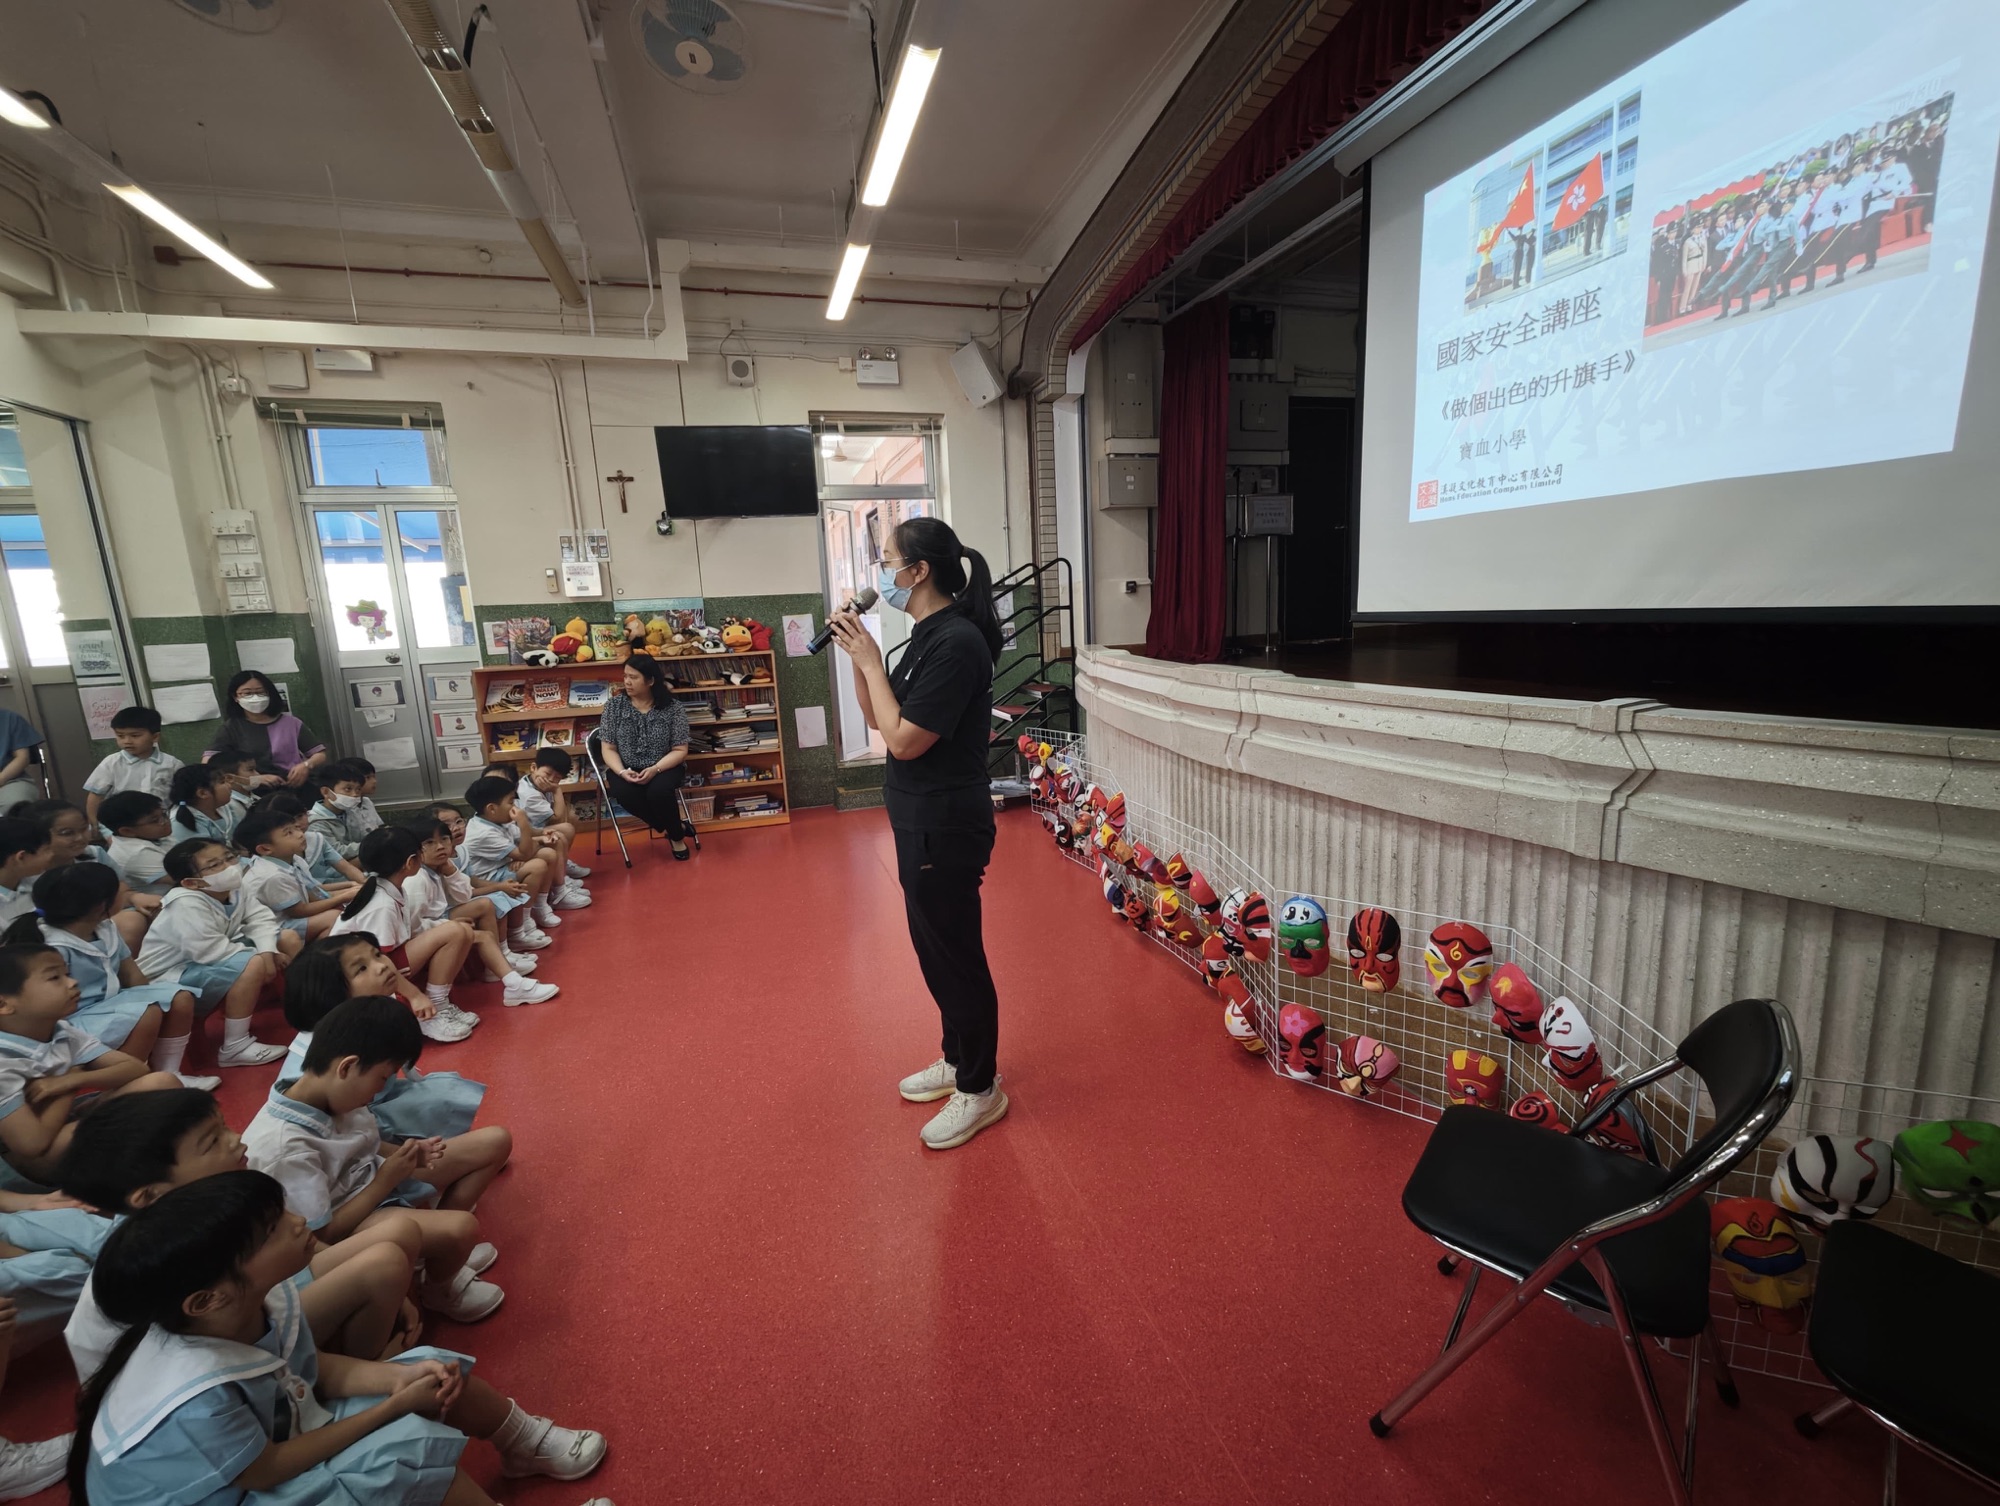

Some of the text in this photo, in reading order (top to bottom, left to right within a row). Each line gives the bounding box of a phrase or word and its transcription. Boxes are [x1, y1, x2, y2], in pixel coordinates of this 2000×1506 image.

[1437, 287, 1602, 371] 國家安全講座
[1442, 349, 1636, 421] 《做個出色的升旗手》
[1459, 429, 1526, 461] 寶血小學
[1457, 489, 1492, 501] Education
[1494, 484, 1527, 496] Company
[1531, 477, 1561, 489] Limited
